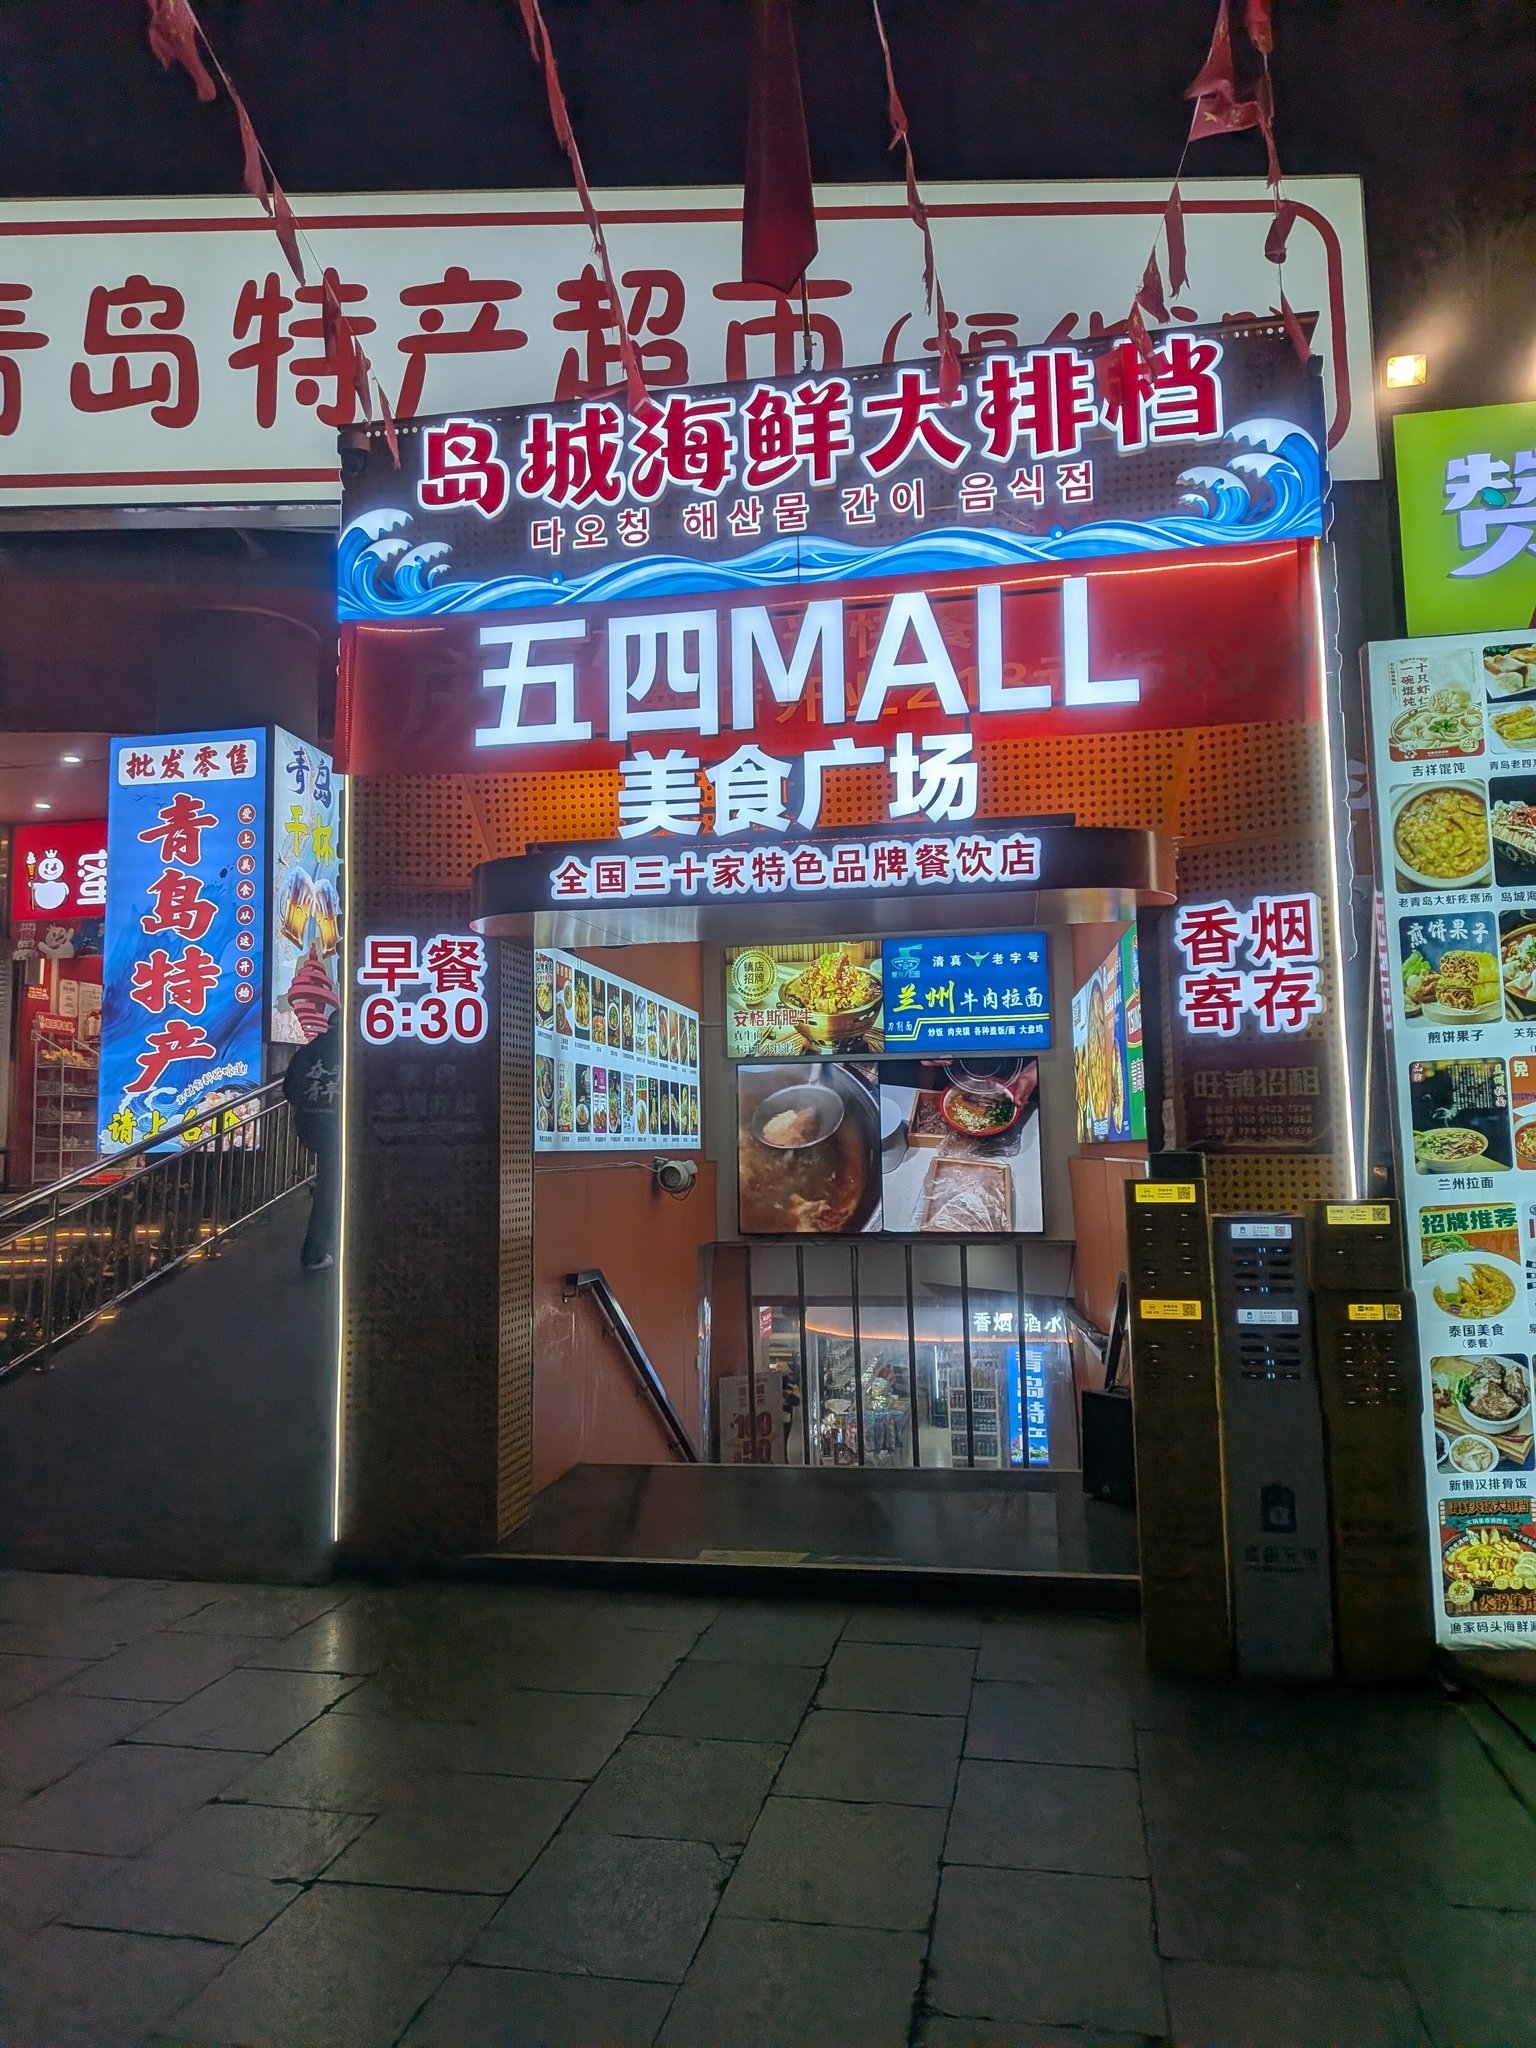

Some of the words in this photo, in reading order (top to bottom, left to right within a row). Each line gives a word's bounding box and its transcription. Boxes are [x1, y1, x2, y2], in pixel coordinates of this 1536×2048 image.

[418, 335, 1224, 518] 岛城海鲜大排档
[530, 508, 650, 554] 다오청
[684, 491, 809, 539] 해산물
[841, 478, 926, 525] 간이
[958, 461, 1094, 514] 음식점
[475, 577, 1140, 748] 五四MALL
[126, 743, 250, 779] 批发零售
[1411, 762, 1466, 777] 吉祥馄饨
[1489, 759, 1536, 771] 青岛老四
[618, 732, 979, 840] 美食广场
[285, 805, 335, 867] 干杯
[552, 837, 1041, 899] 全国三十家特色品牌餐饮店
[237, 806, 254, 1001] 爱上美食从这开始
[1398, 892, 1493, 909] 老青岛大虾疙瘩汤
[124, 792, 222, 1094] 青岛特产
[1179, 897, 1315, 967] 香烟
[1406, 919, 1489, 948] 煎饼果子
[361, 937, 486, 997] 早餐
[932, 954, 962, 968] 清真
[992, 951, 1039, 965] 老字号
[893, 980, 1043, 1013] 兰州牛肉拉面
[1183, 966, 1319, 1032] 寄存
[364, 995, 485, 1043] 6:30
[734, 1008, 814, 1027] 安格斯肥牛
[1427, 1029, 1484, 1044] 煎饼果子
[1438, 1176, 1493, 1191] 兰州拉面
[1421, 1207, 1518, 1235] 招牌推荐
[1448, 1323, 1504, 1338] 泰国美食
[1449, 1477, 1527, 1491] 新懒汉排骨饭
